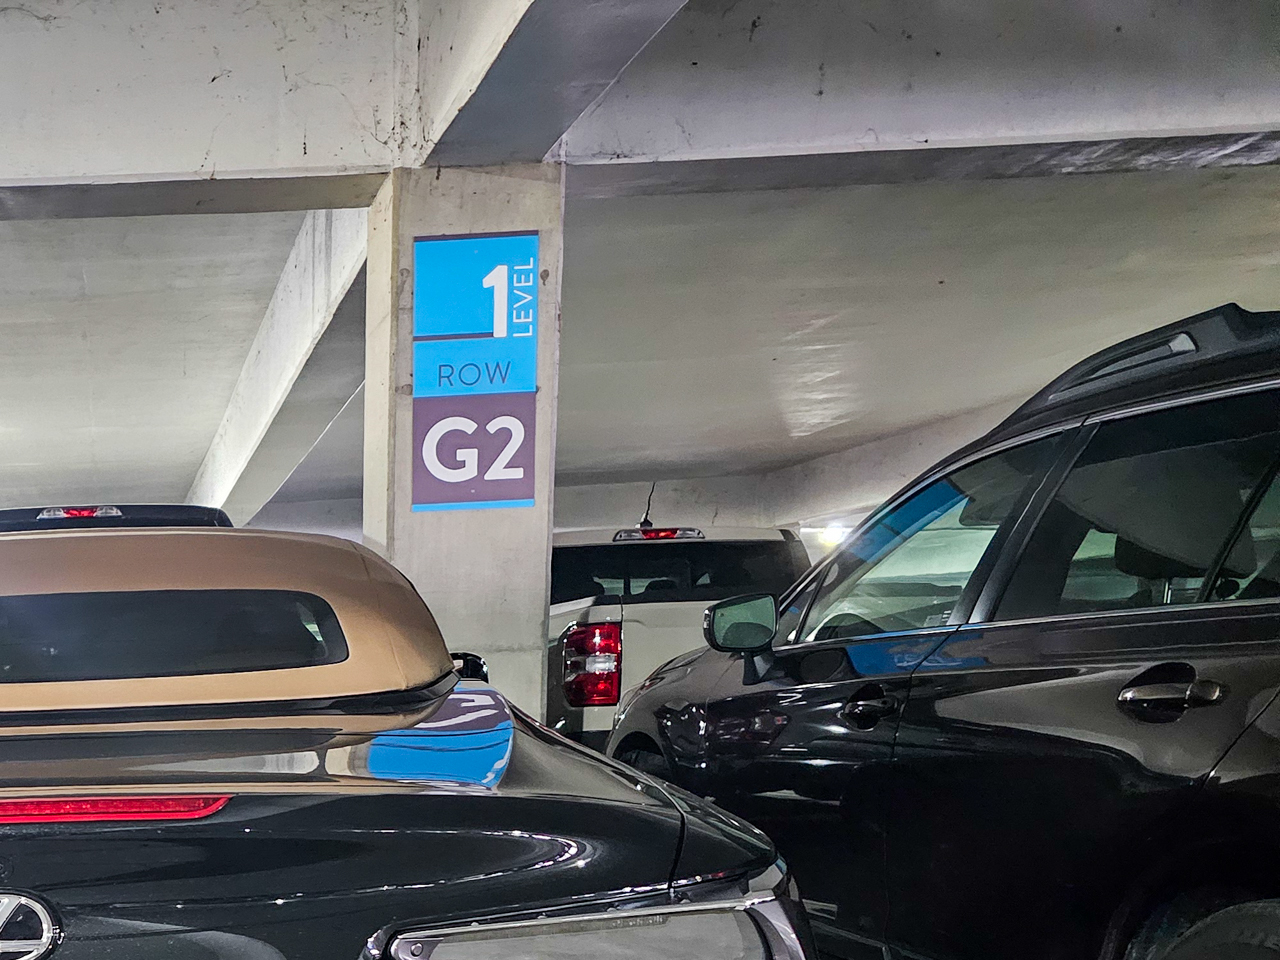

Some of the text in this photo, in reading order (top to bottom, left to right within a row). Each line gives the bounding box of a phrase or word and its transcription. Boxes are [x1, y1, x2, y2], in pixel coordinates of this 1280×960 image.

[482, 264, 508, 338] 1
[512, 257, 534, 337] LEVEL
[438, 361, 511, 387] ROW
[422, 415, 525, 483] G2
